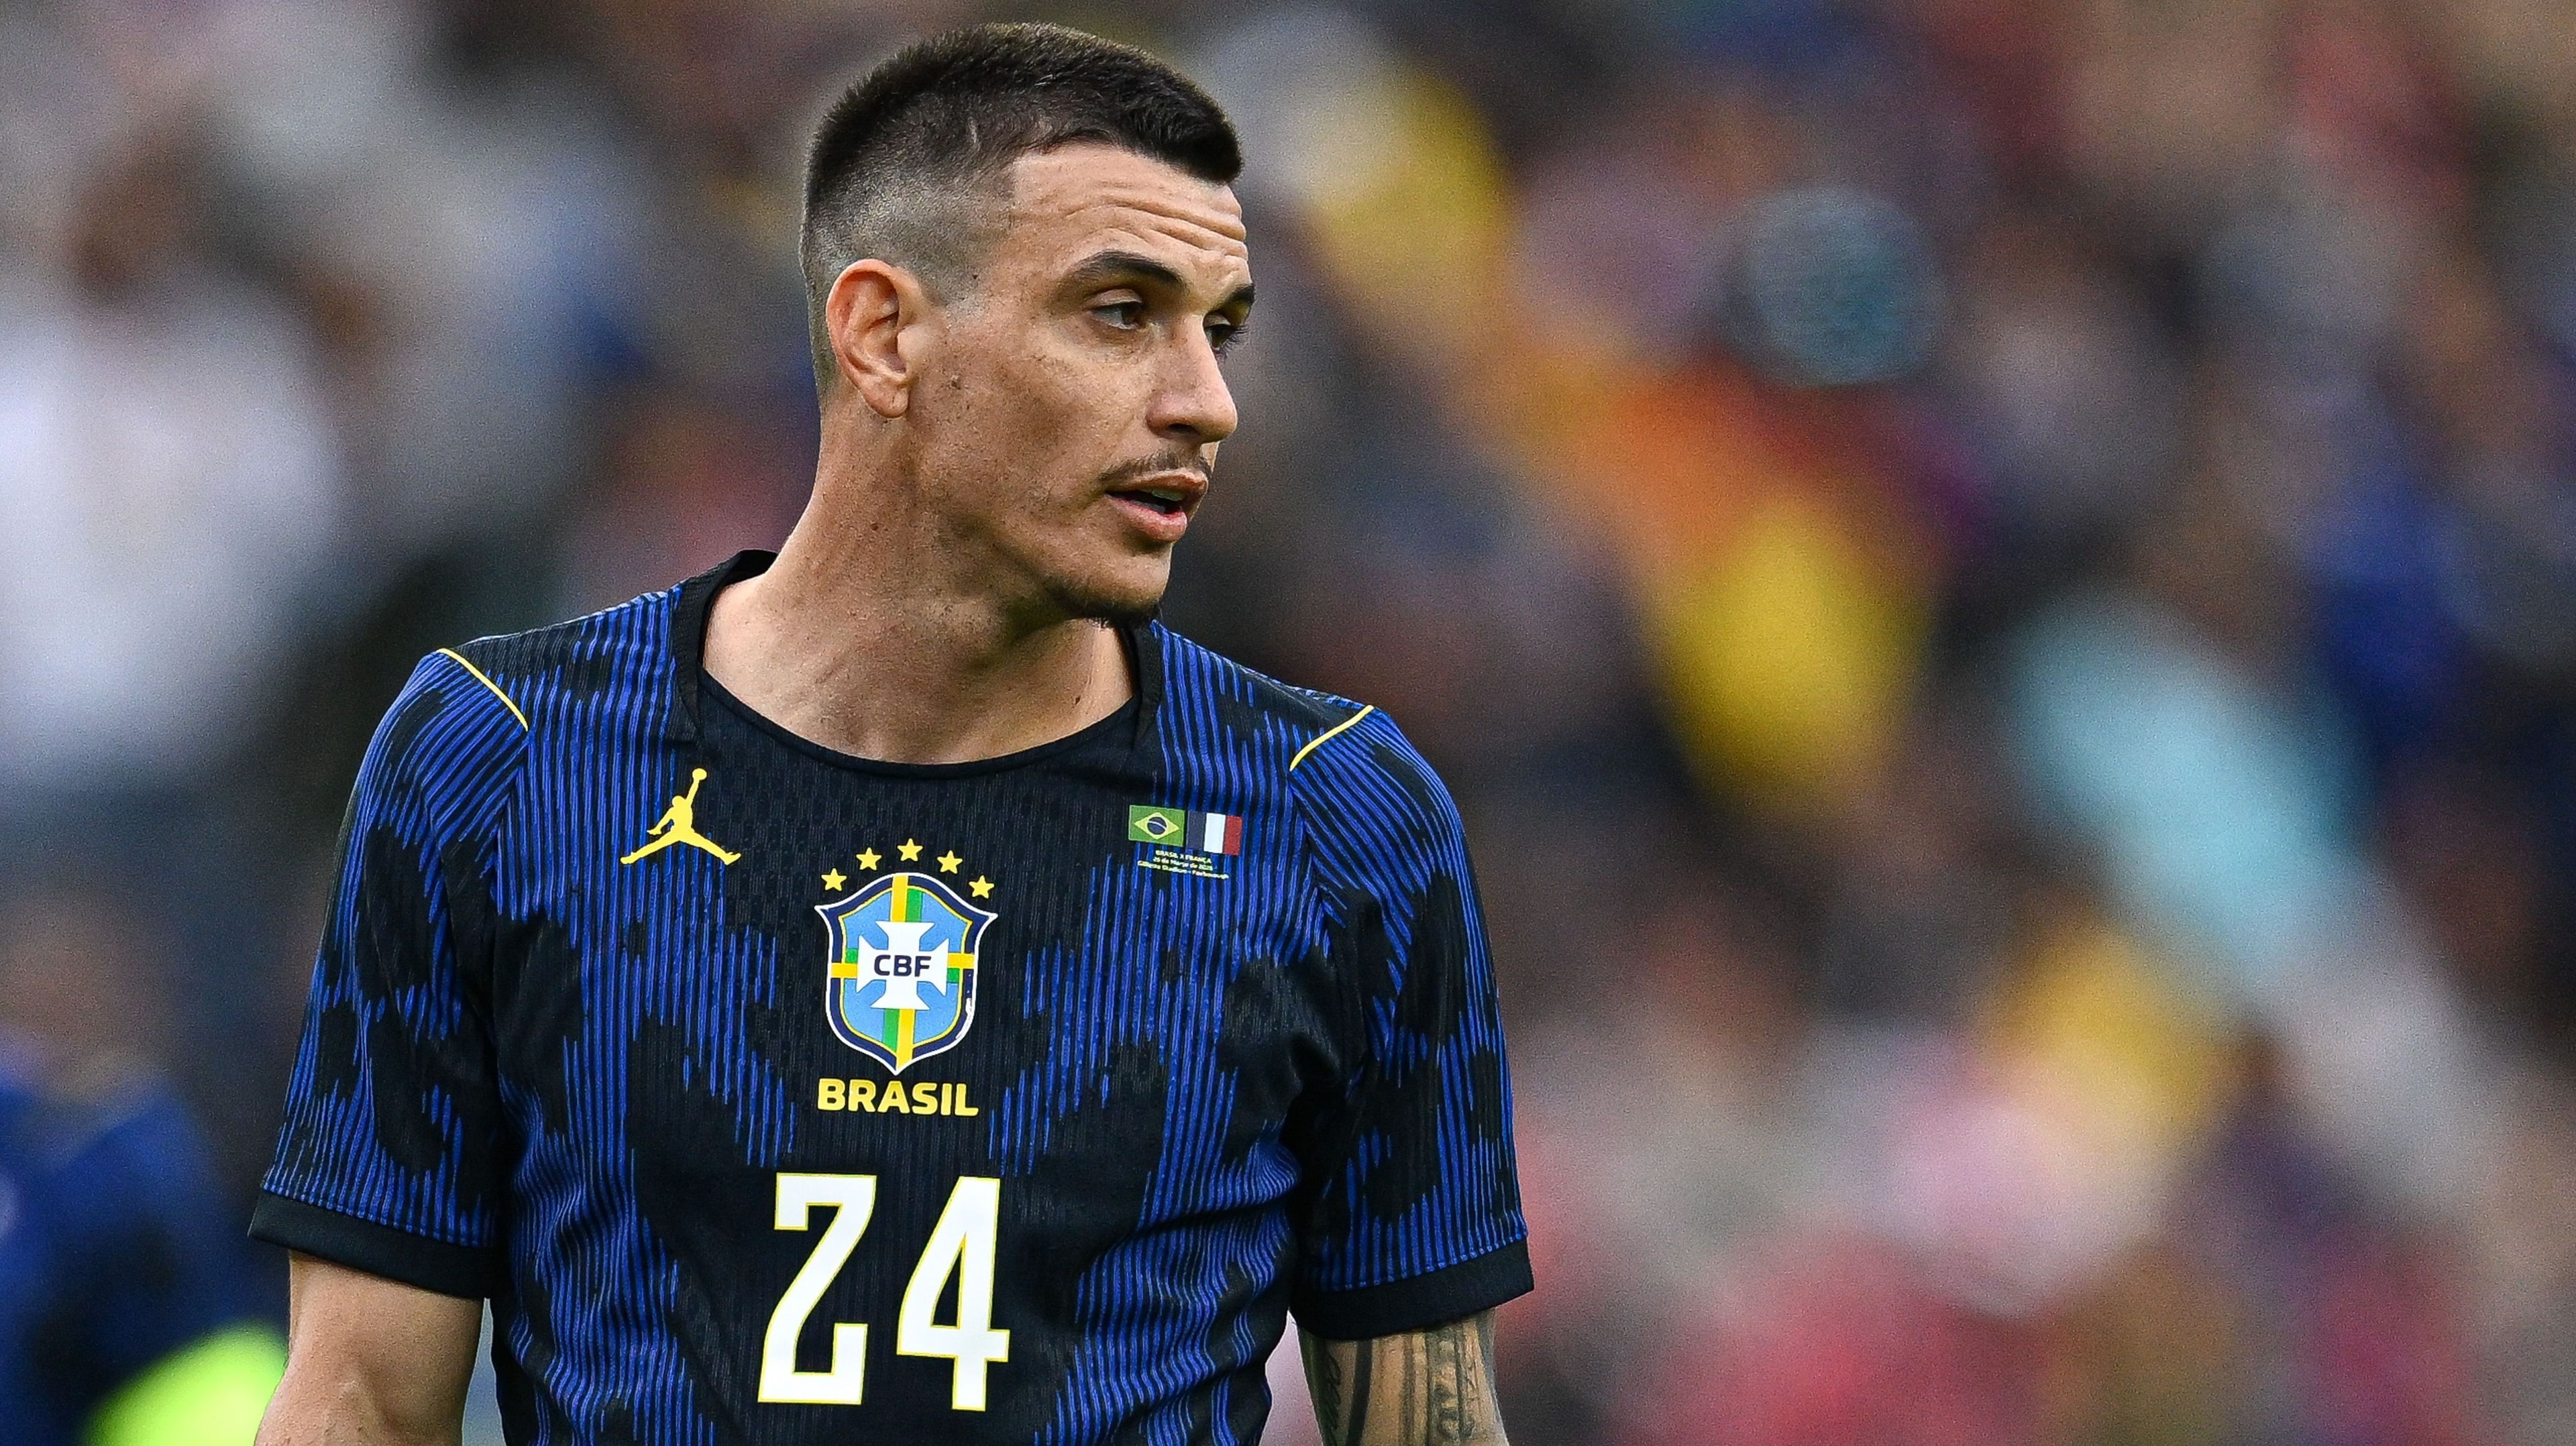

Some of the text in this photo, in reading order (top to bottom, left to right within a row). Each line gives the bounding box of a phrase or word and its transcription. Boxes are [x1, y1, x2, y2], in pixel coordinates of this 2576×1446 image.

[873, 954, 932, 978] CBF
[817, 1078, 979, 1117] BRASIL
[757, 1172, 1010, 1412] 24
